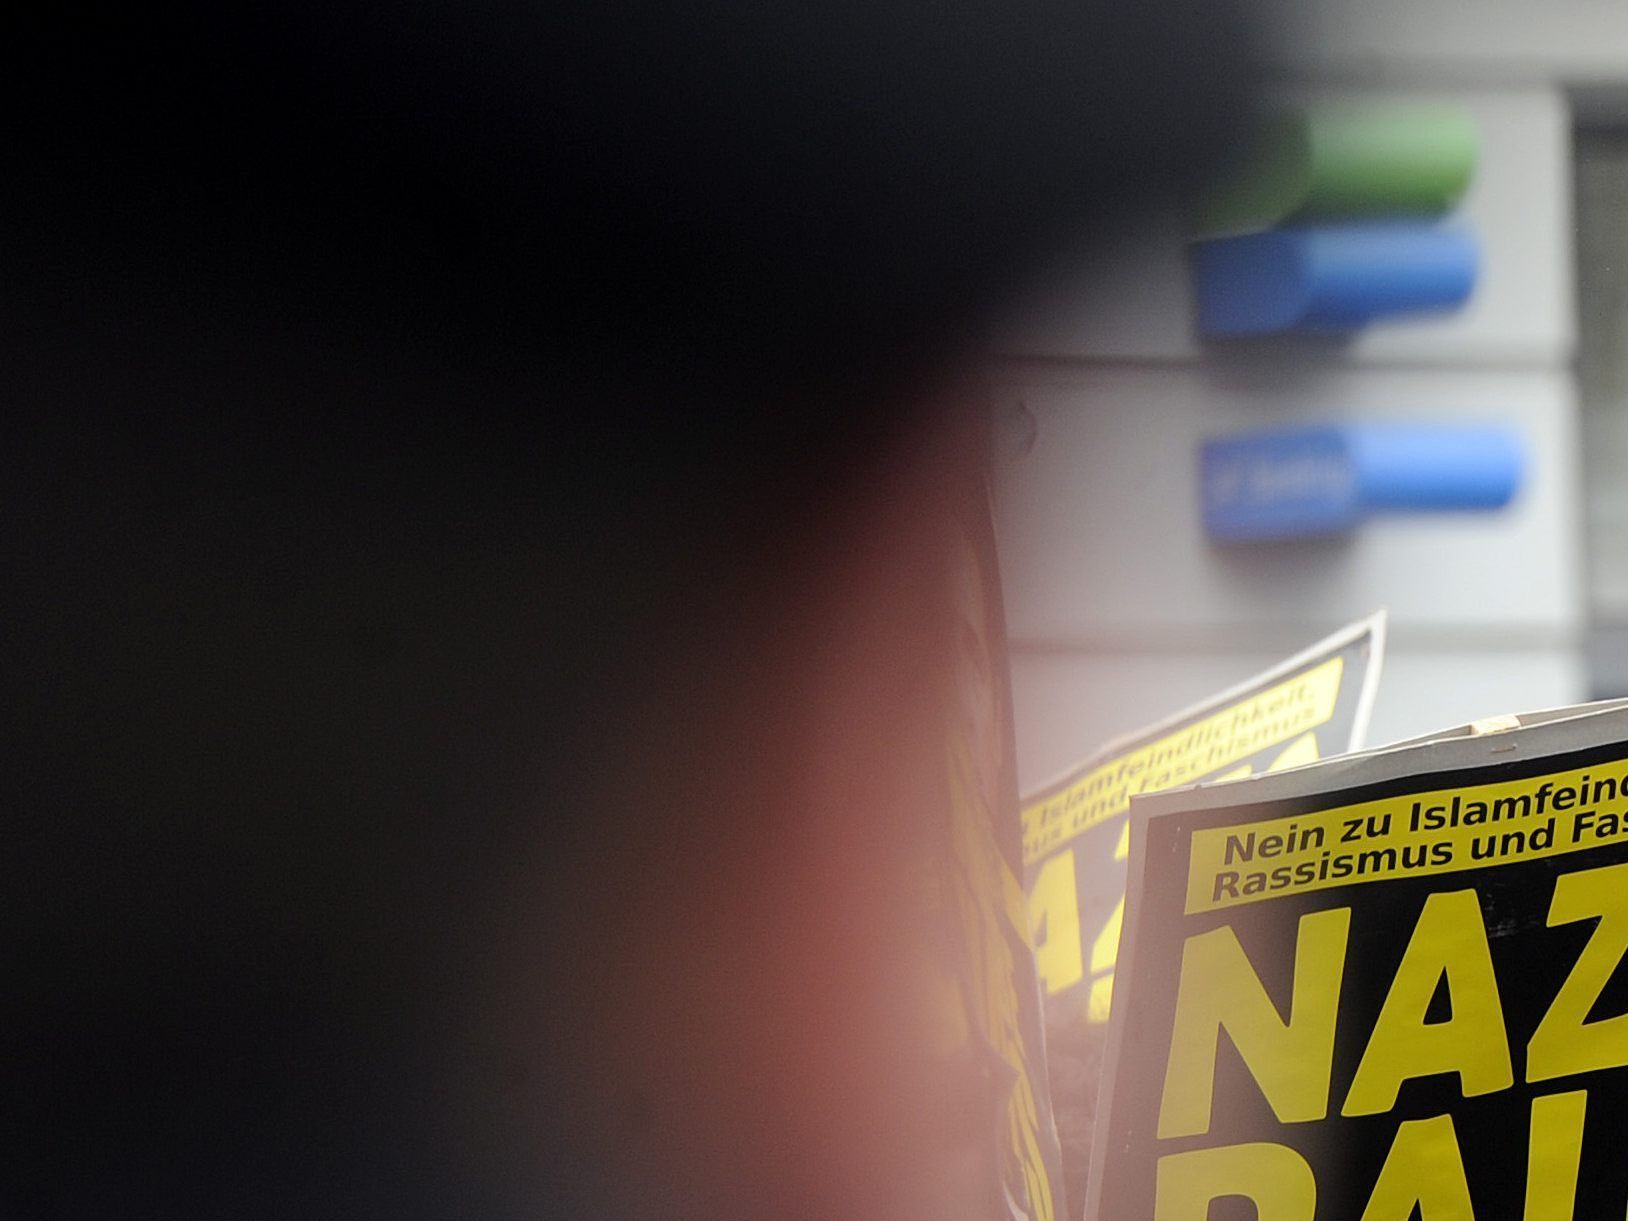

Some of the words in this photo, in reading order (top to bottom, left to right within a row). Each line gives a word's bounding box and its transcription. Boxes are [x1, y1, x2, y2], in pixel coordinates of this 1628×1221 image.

[1212, 841, 1453, 902] Rassismus
[1471, 818, 1556, 860] und
[1224, 823, 1325, 866] Nein
[1340, 813, 1392, 844] zu
